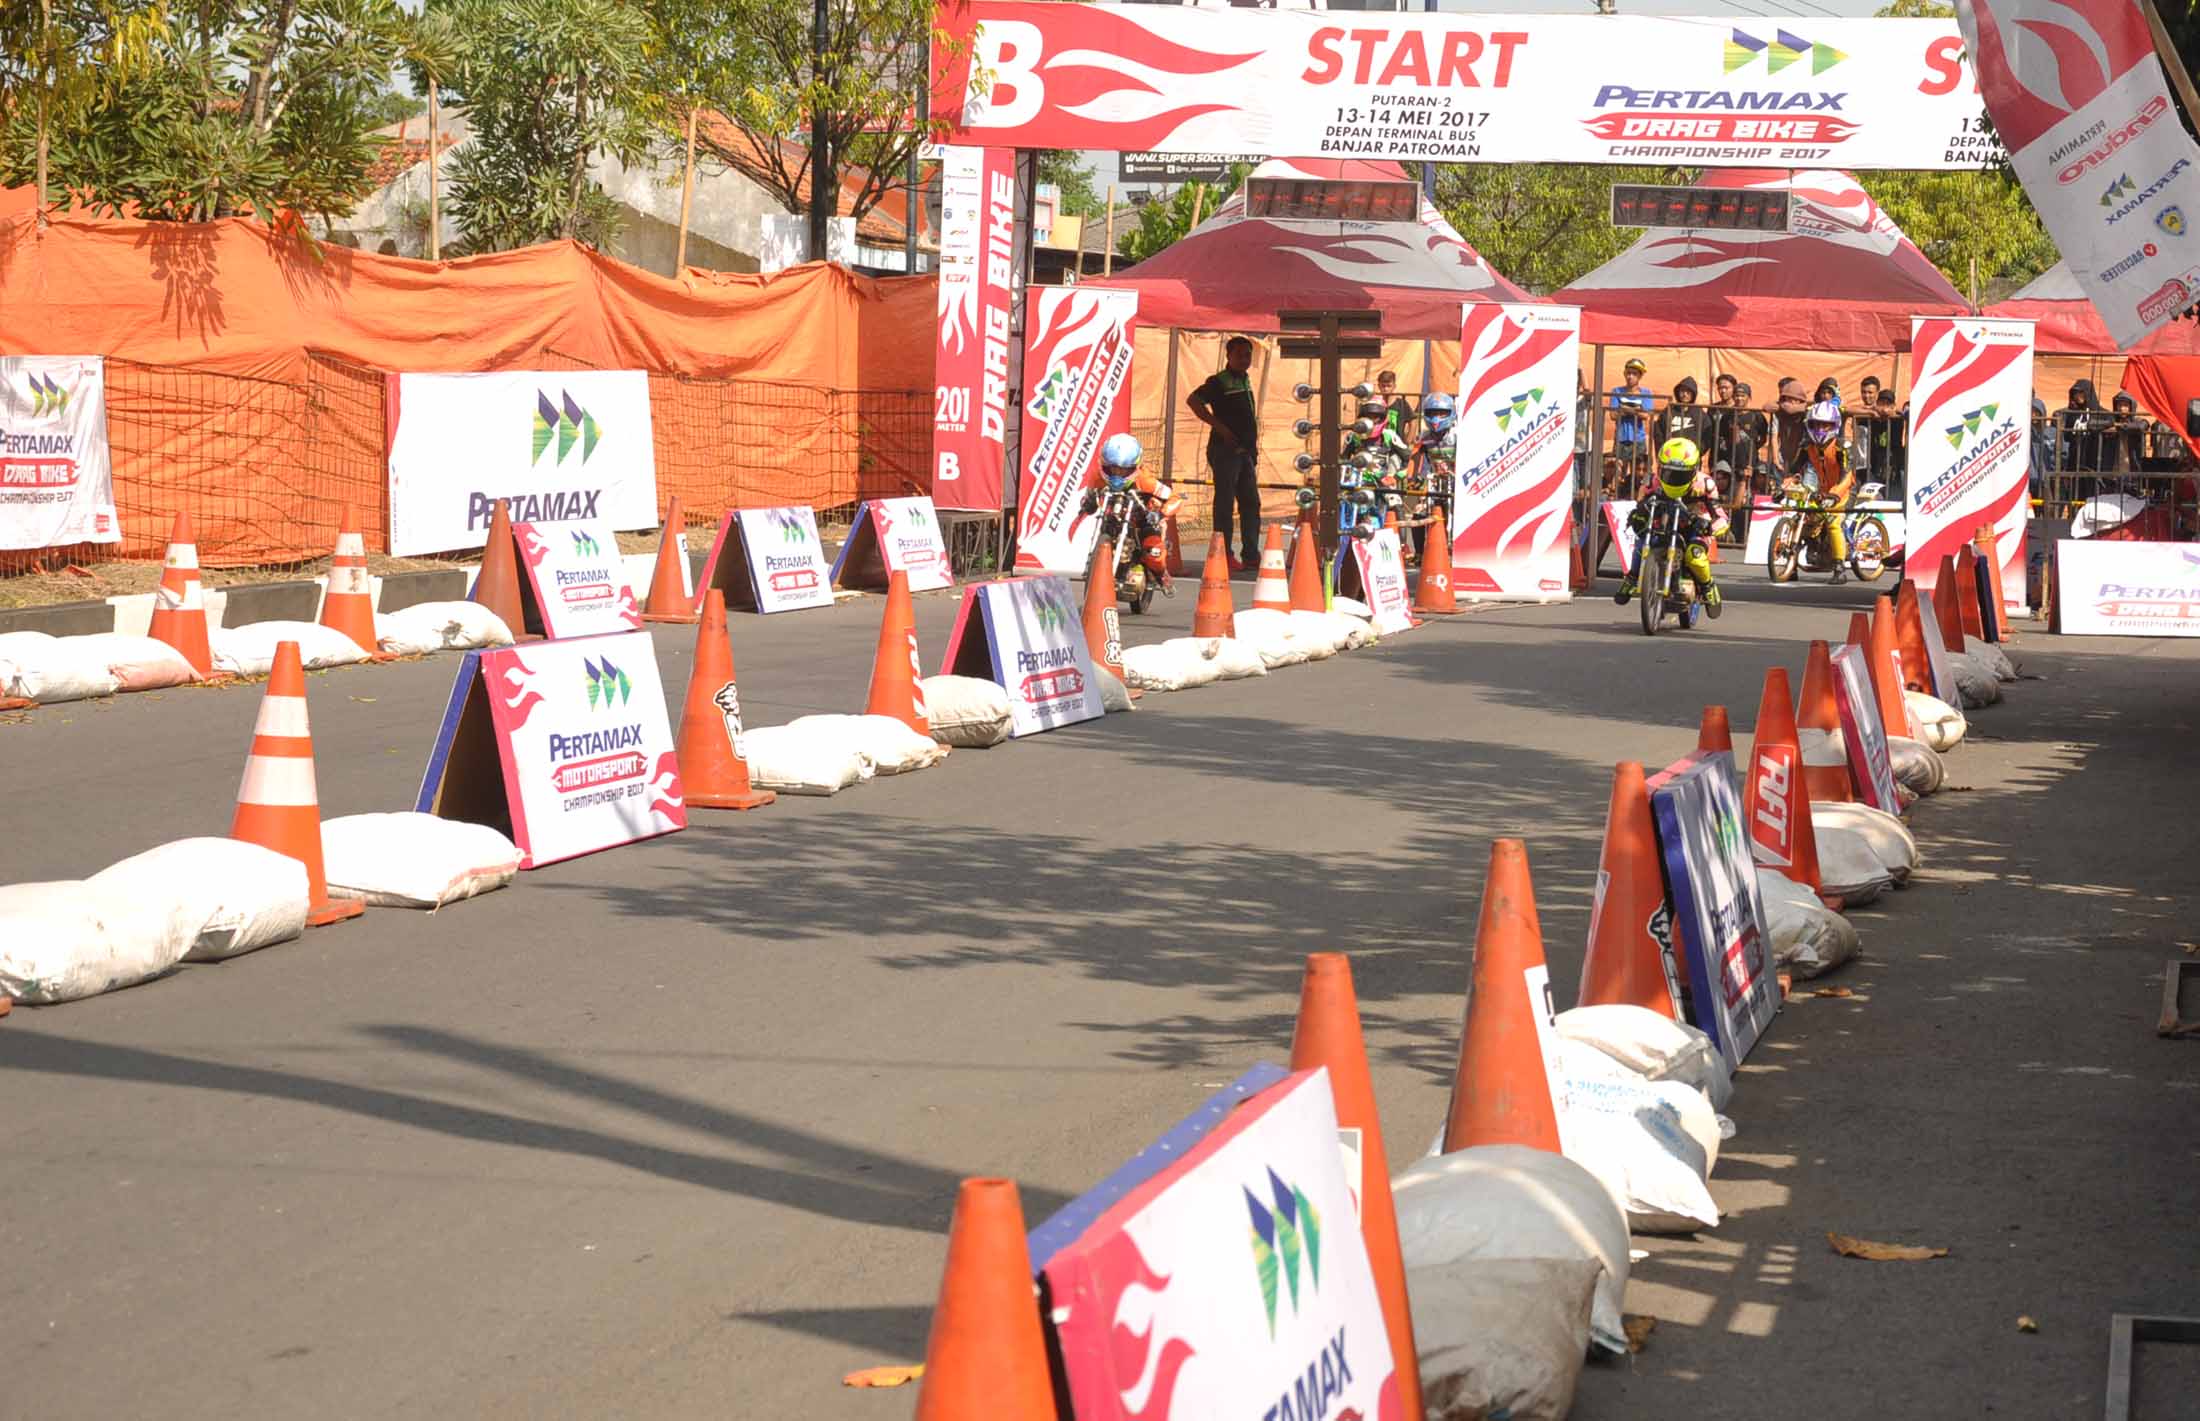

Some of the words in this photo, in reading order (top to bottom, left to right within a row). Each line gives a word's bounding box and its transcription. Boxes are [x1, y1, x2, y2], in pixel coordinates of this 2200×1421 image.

[1301, 27, 1528, 88] START
[960, 19, 1045, 128] B
[1372, 95, 1452, 107] PUTARAN-2
[1593, 85, 1848, 111] PERTAMAX
[1336, 108, 1391, 125] 13-14
[1397, 111, 1432, 126] MEI
[1440, 112, 1490, 127] 2017
[1622, 119, 1723, 138] DRAG
[1732, 120, 1820, 139] BIKE
[1321, 139, 1384, 154] BANJAR
[1389, 142, 1481, 157] PATROMAN
[1326, 126, 1373, 139] DEPAN
[1377, 127, 1444, 141] TERMINAL
[1449, 130, 1476, 142] BUS
[1609, 146, 1771, 158] CHAMPIONSHIP
[1779, 148, 1831, 160] 2017
[987, 170, 1014, 290] BIKE
[981, 303, 1009, 443] DRAG
[935, 386, 970, 423] 201
[1033, 372, 1081, 475] PERTAMAX
[1033, 344, 1112, 519] MOTORSPORT
[1049, 395, 1108, 533] CHAMPIONSHIP
[1107, 348, 1130, 393] 2016
[1461, 401, 1561, 487] PERTAMAX
[938, 452, 960, 481] B
[1913, 416, 2015, 506] PERTAMAX
[556, 568, 610, 586] PERTAMAX
[765, 555, 814, 571] PERTAMAX
[1017, 646, 1076, 672] PERTAMAX
[549, 723, 643, 762] PERTAMAX
[562, 755, 639, 788] MOTORSPORT
[564, 787, 625, 812] CHAMPIONSHIP
[627, 783, 645, 797] 2017
